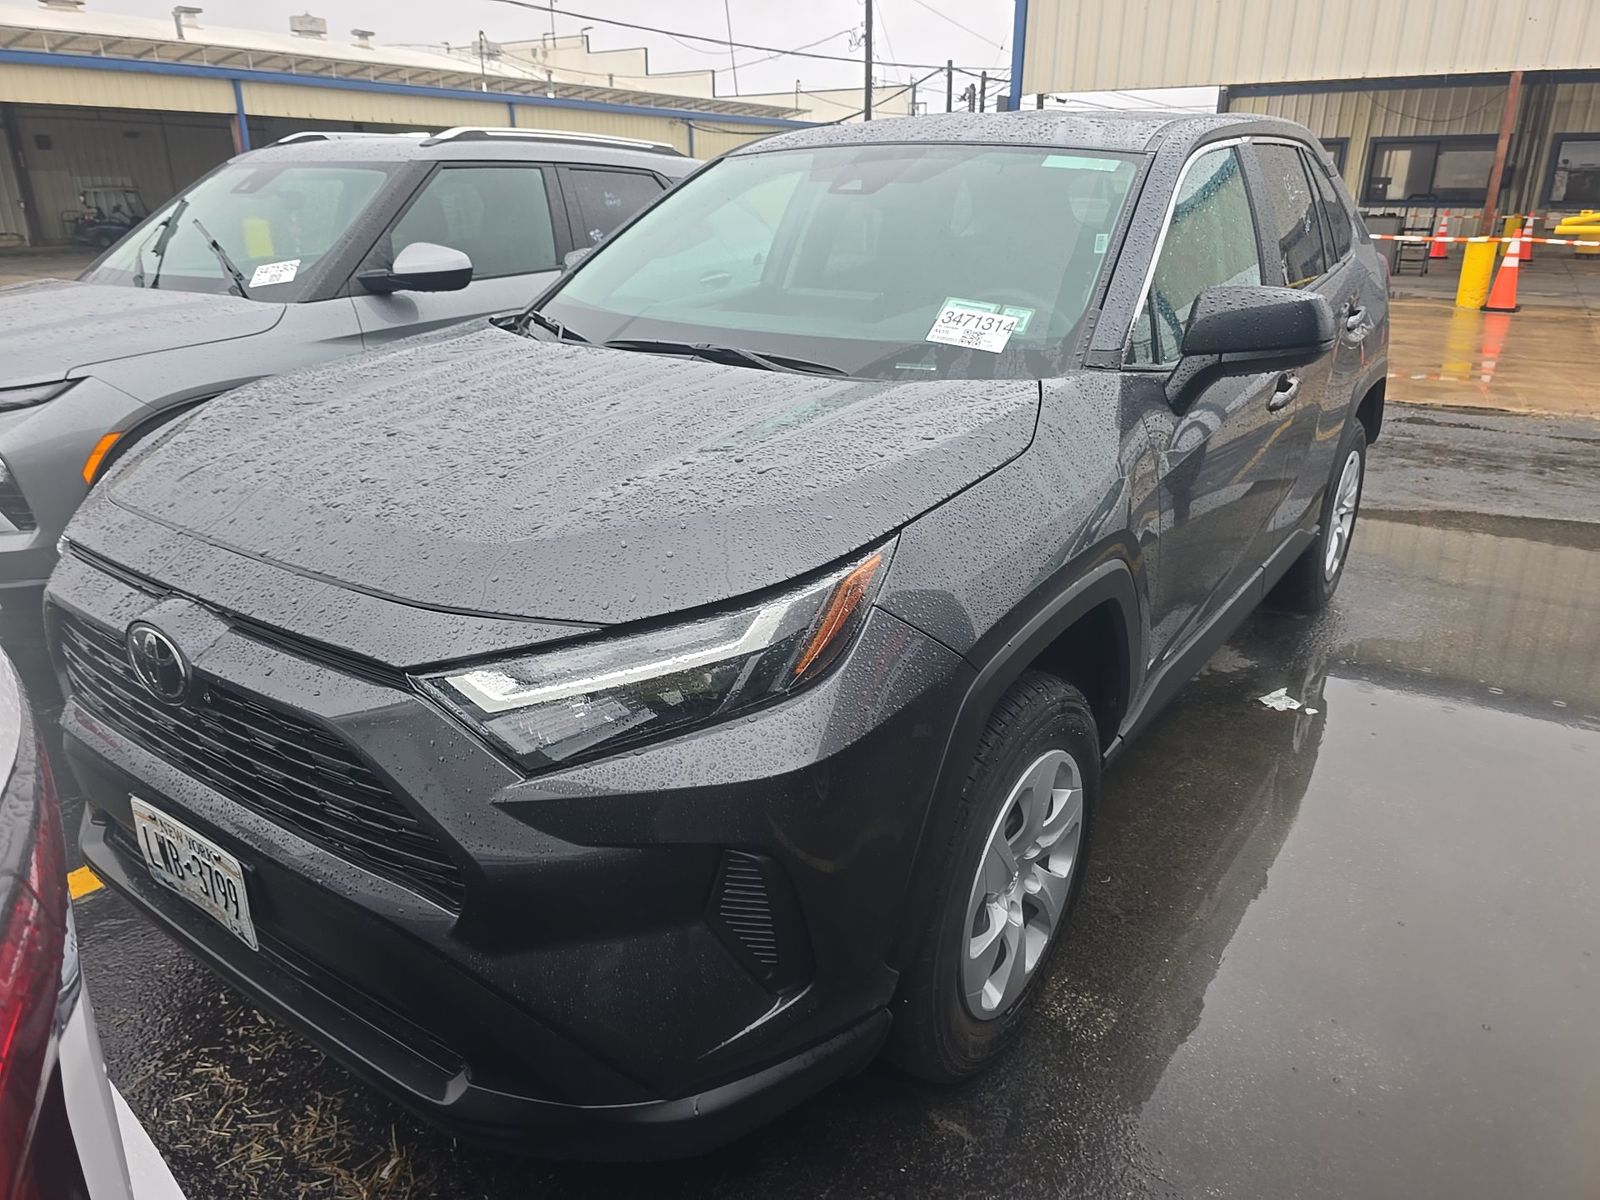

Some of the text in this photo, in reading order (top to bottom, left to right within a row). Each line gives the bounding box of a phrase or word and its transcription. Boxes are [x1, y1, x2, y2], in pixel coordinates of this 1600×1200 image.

[941, 310, 1015, 335] 3471314
[158, 819, 216, 865] NEW YORK
